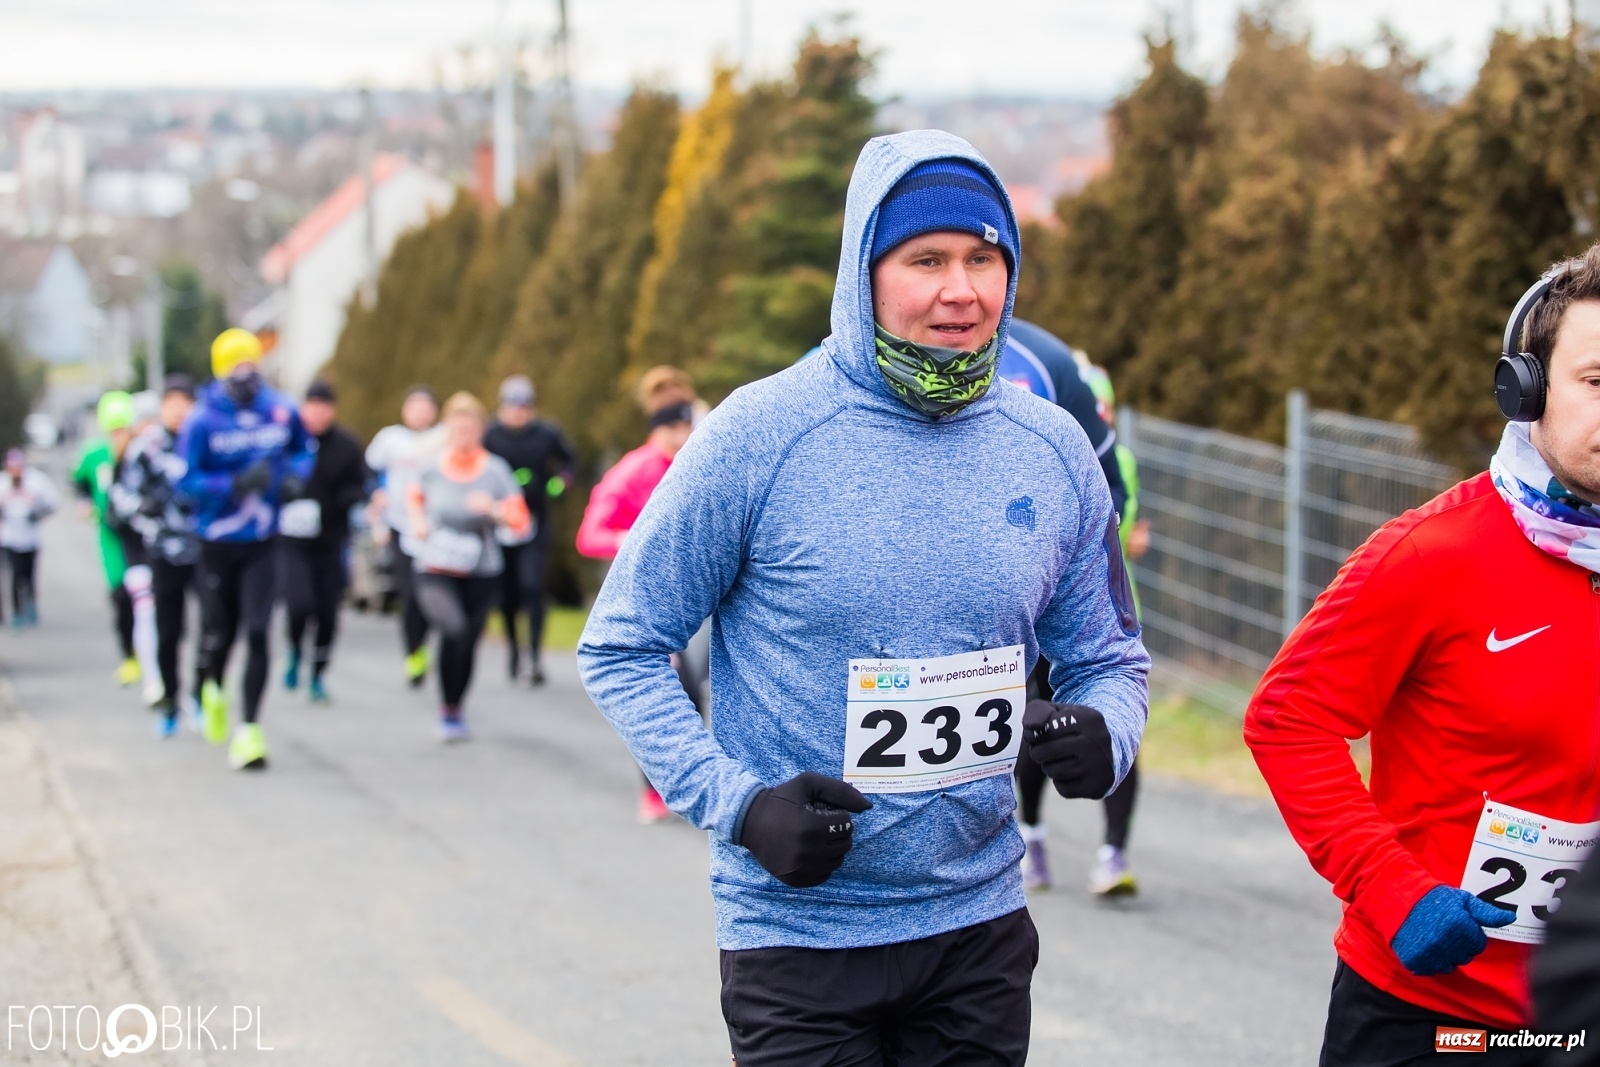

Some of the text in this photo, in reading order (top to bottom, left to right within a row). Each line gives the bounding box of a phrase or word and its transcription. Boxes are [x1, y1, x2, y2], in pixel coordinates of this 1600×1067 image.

[860, 664, 911, 673] PersonalBest
[919, 660, 1018, 685] www.personalbest.pl
[856, 698, 1013, 768] 233
[1033, 714, 1077, 738] PSTA
[1493, 808, 1542, 830] PersonalBest
